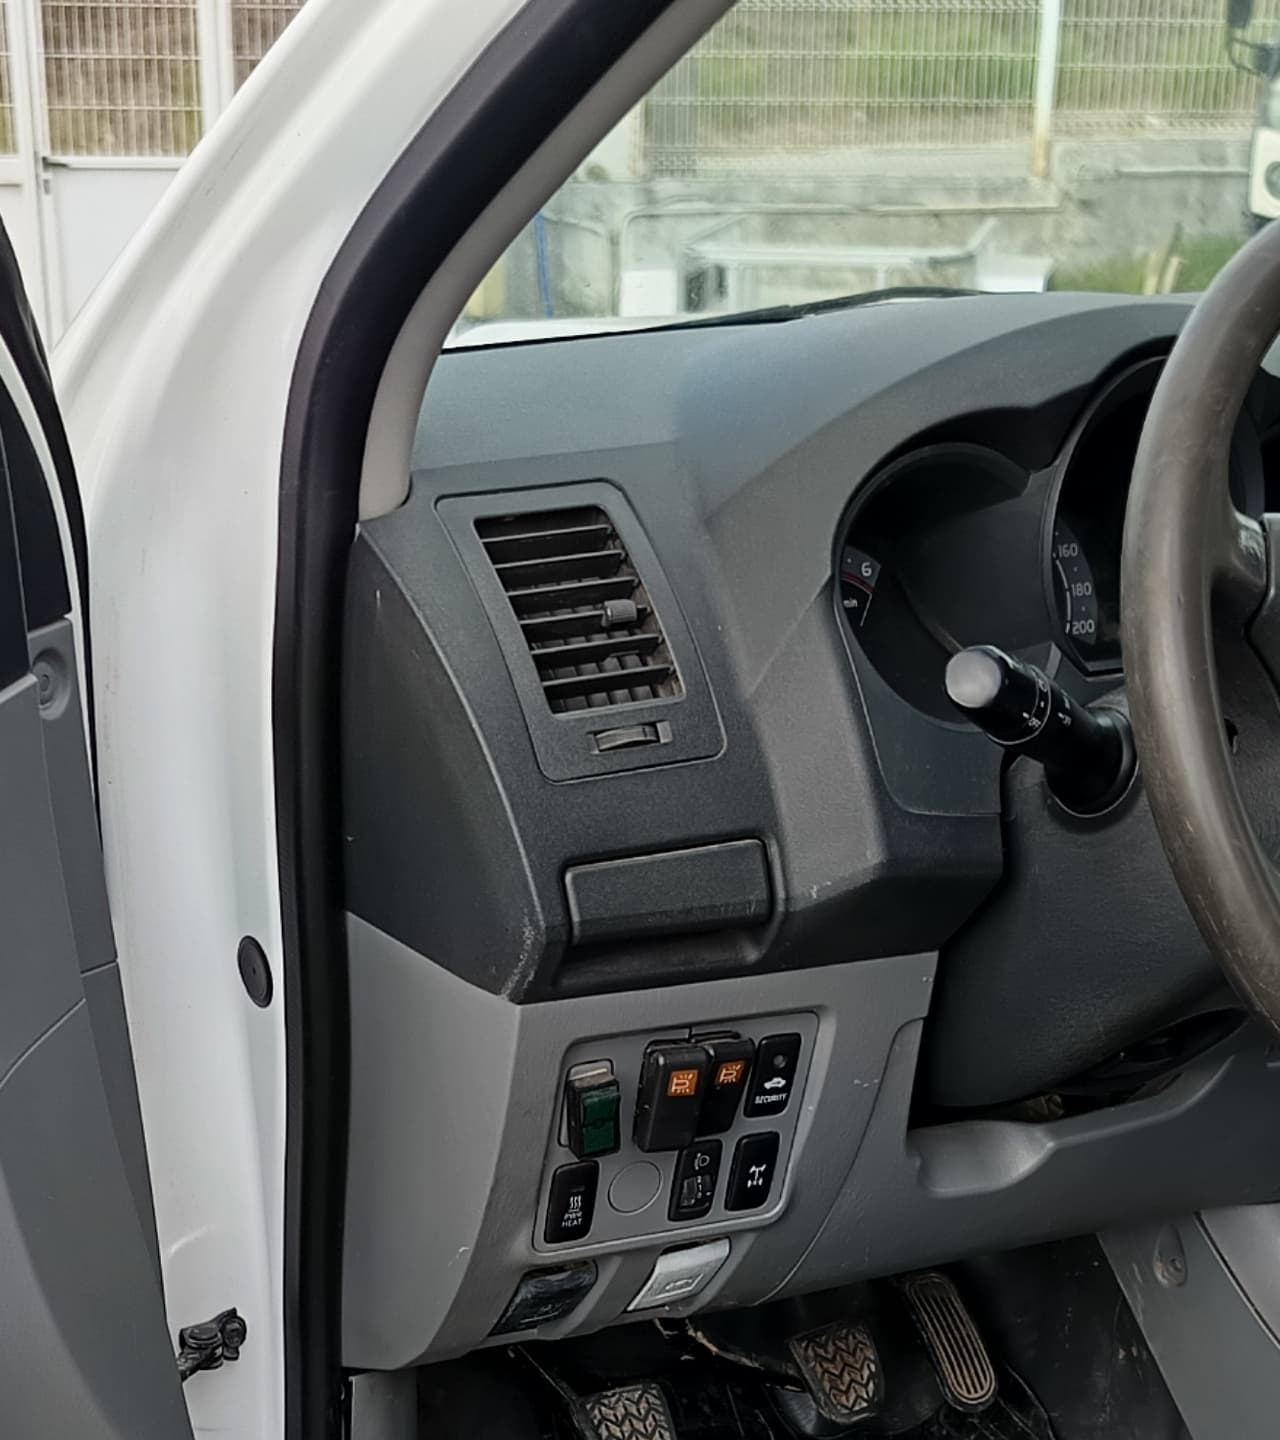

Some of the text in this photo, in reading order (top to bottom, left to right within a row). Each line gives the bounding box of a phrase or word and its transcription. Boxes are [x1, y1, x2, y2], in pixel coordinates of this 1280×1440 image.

[1058, 543, 1078, 557] 160
[861, 562, 872, 577] 6
[1072, 582, 1092, 597] 180
[1072, 619, 1095, 634] 200
[755, 1093, 788, 1105] SECURITY
[561, 1218, 583, 1228] HEAT
